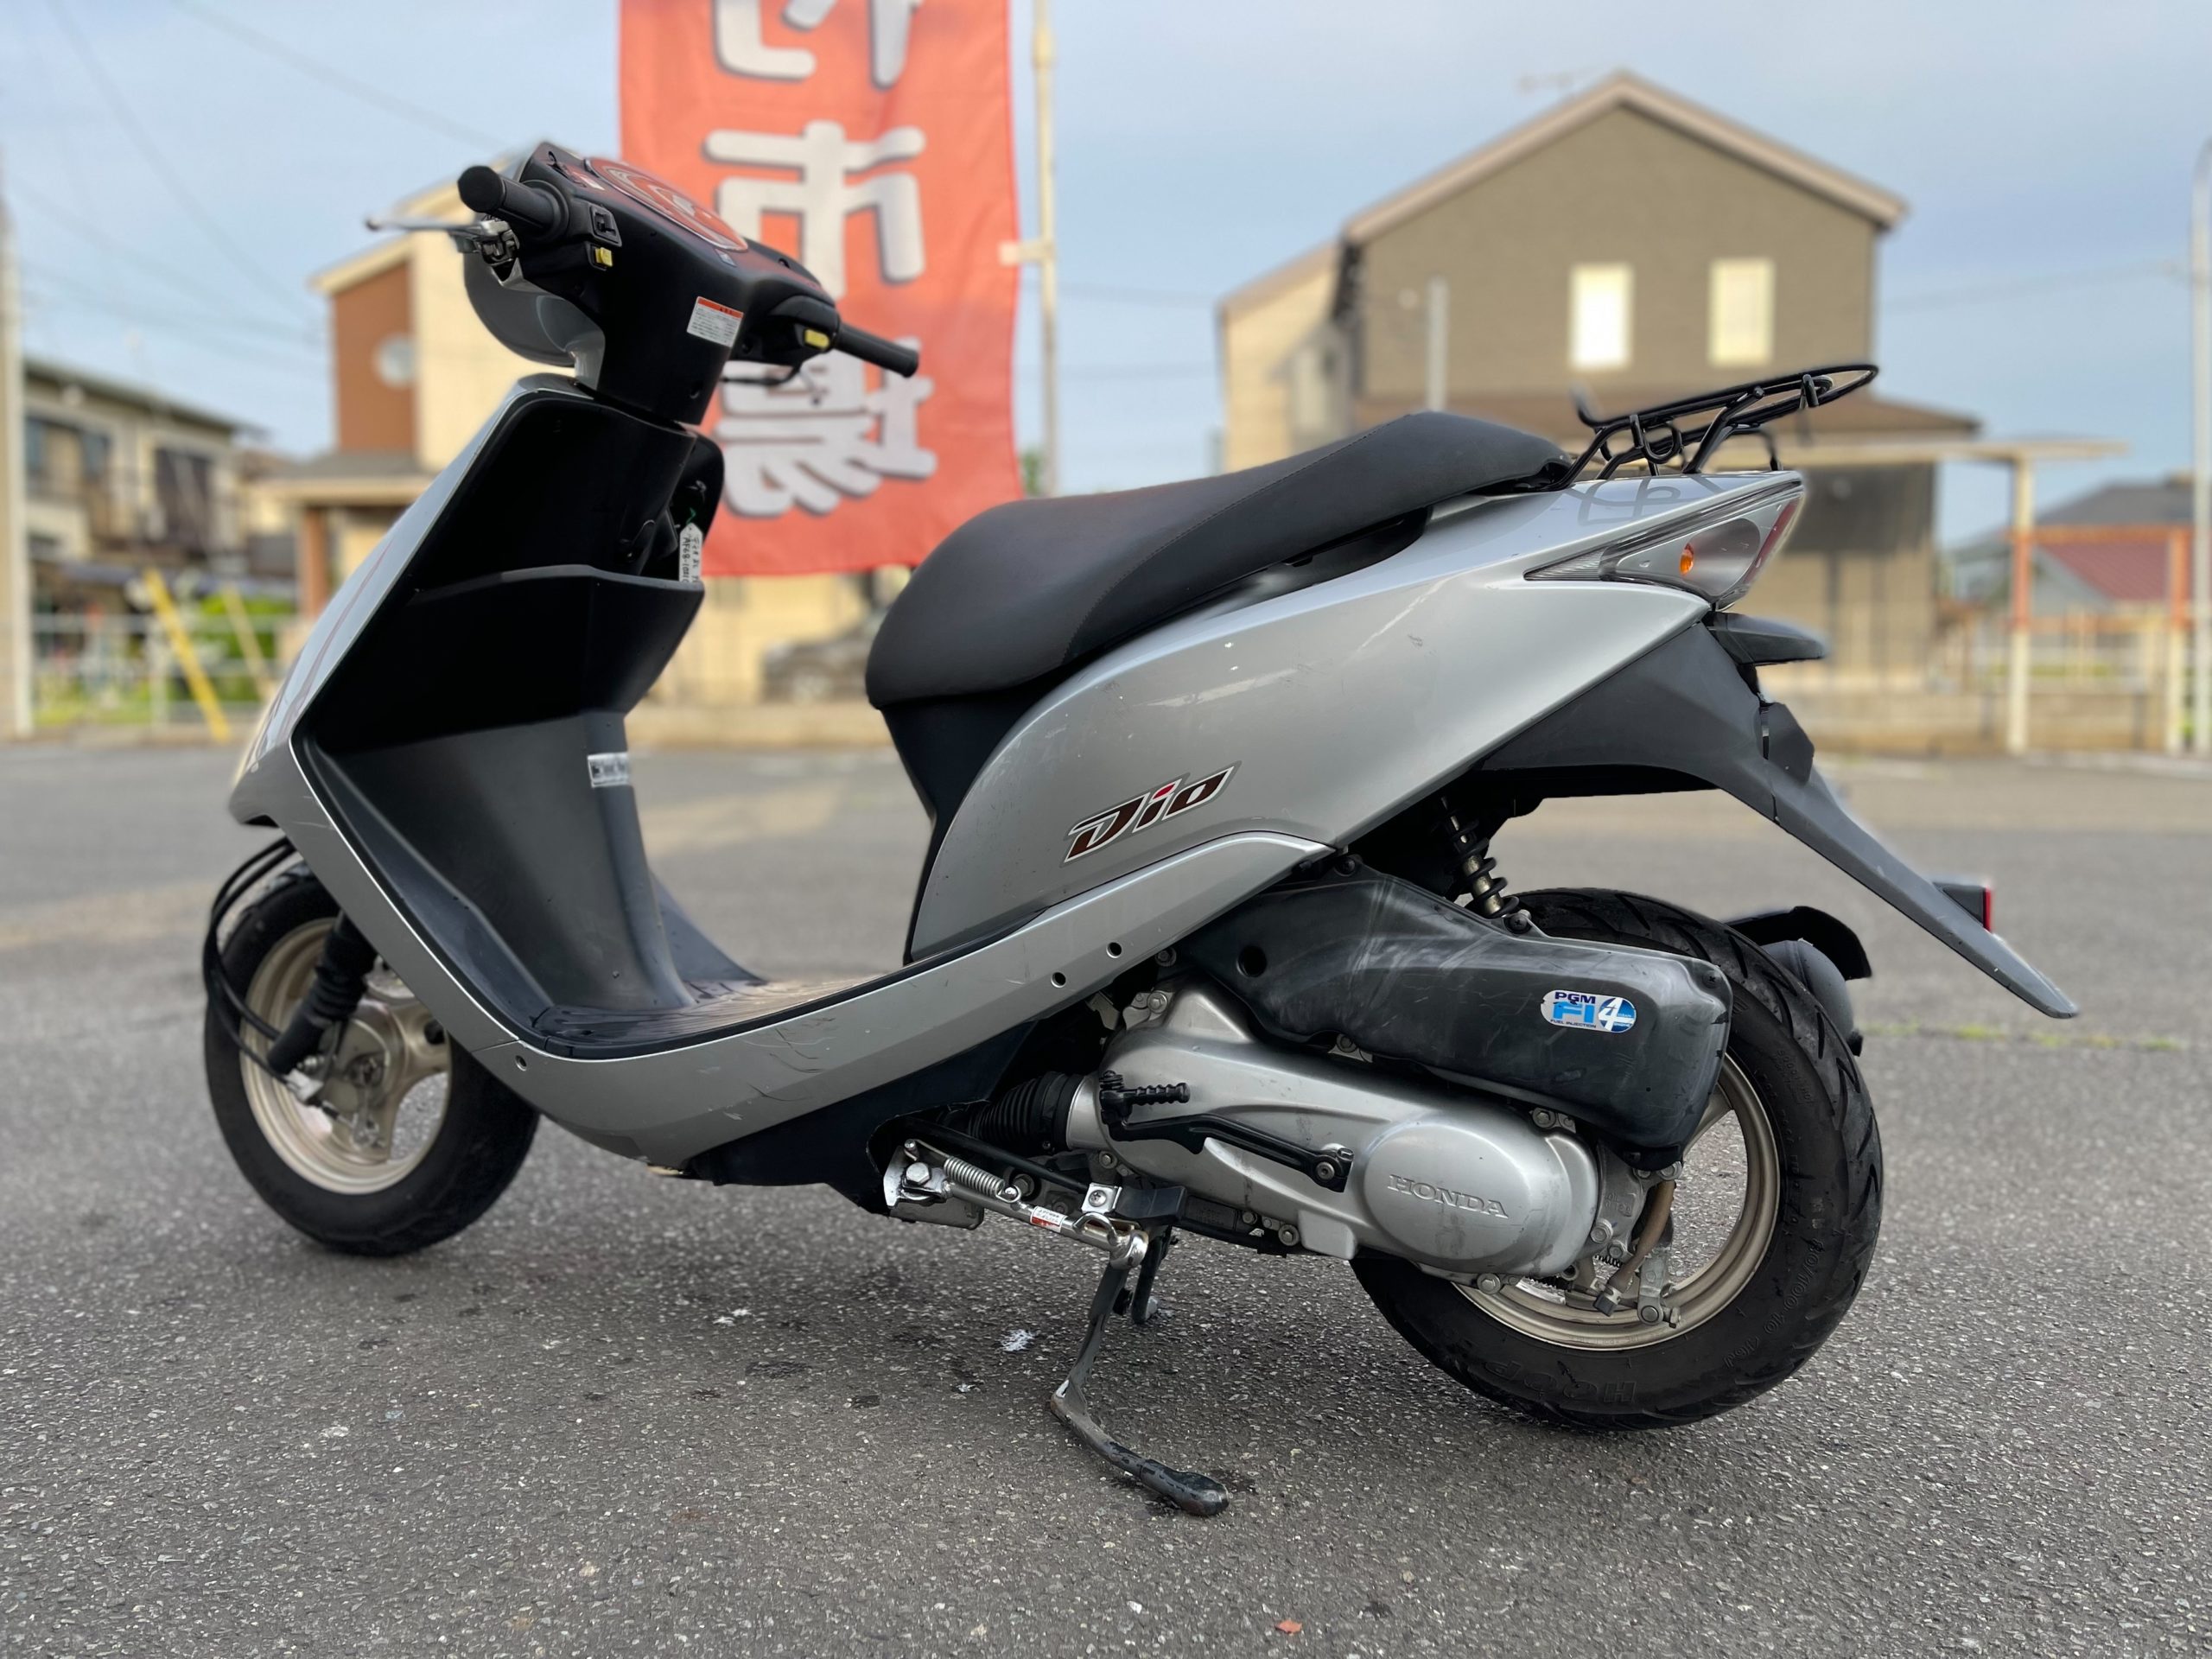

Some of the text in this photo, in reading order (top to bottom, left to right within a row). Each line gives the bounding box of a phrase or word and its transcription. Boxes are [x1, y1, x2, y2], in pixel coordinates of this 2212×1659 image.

[1063, 766, 1235, 863] Dio
[1553, 1001, 1596, 1024] FI
[1554, 991, 1596, 1005] PGM
[1599, 996, 1636, 1031] 4
[1387, 1173, 1509, 1219] HONDA
